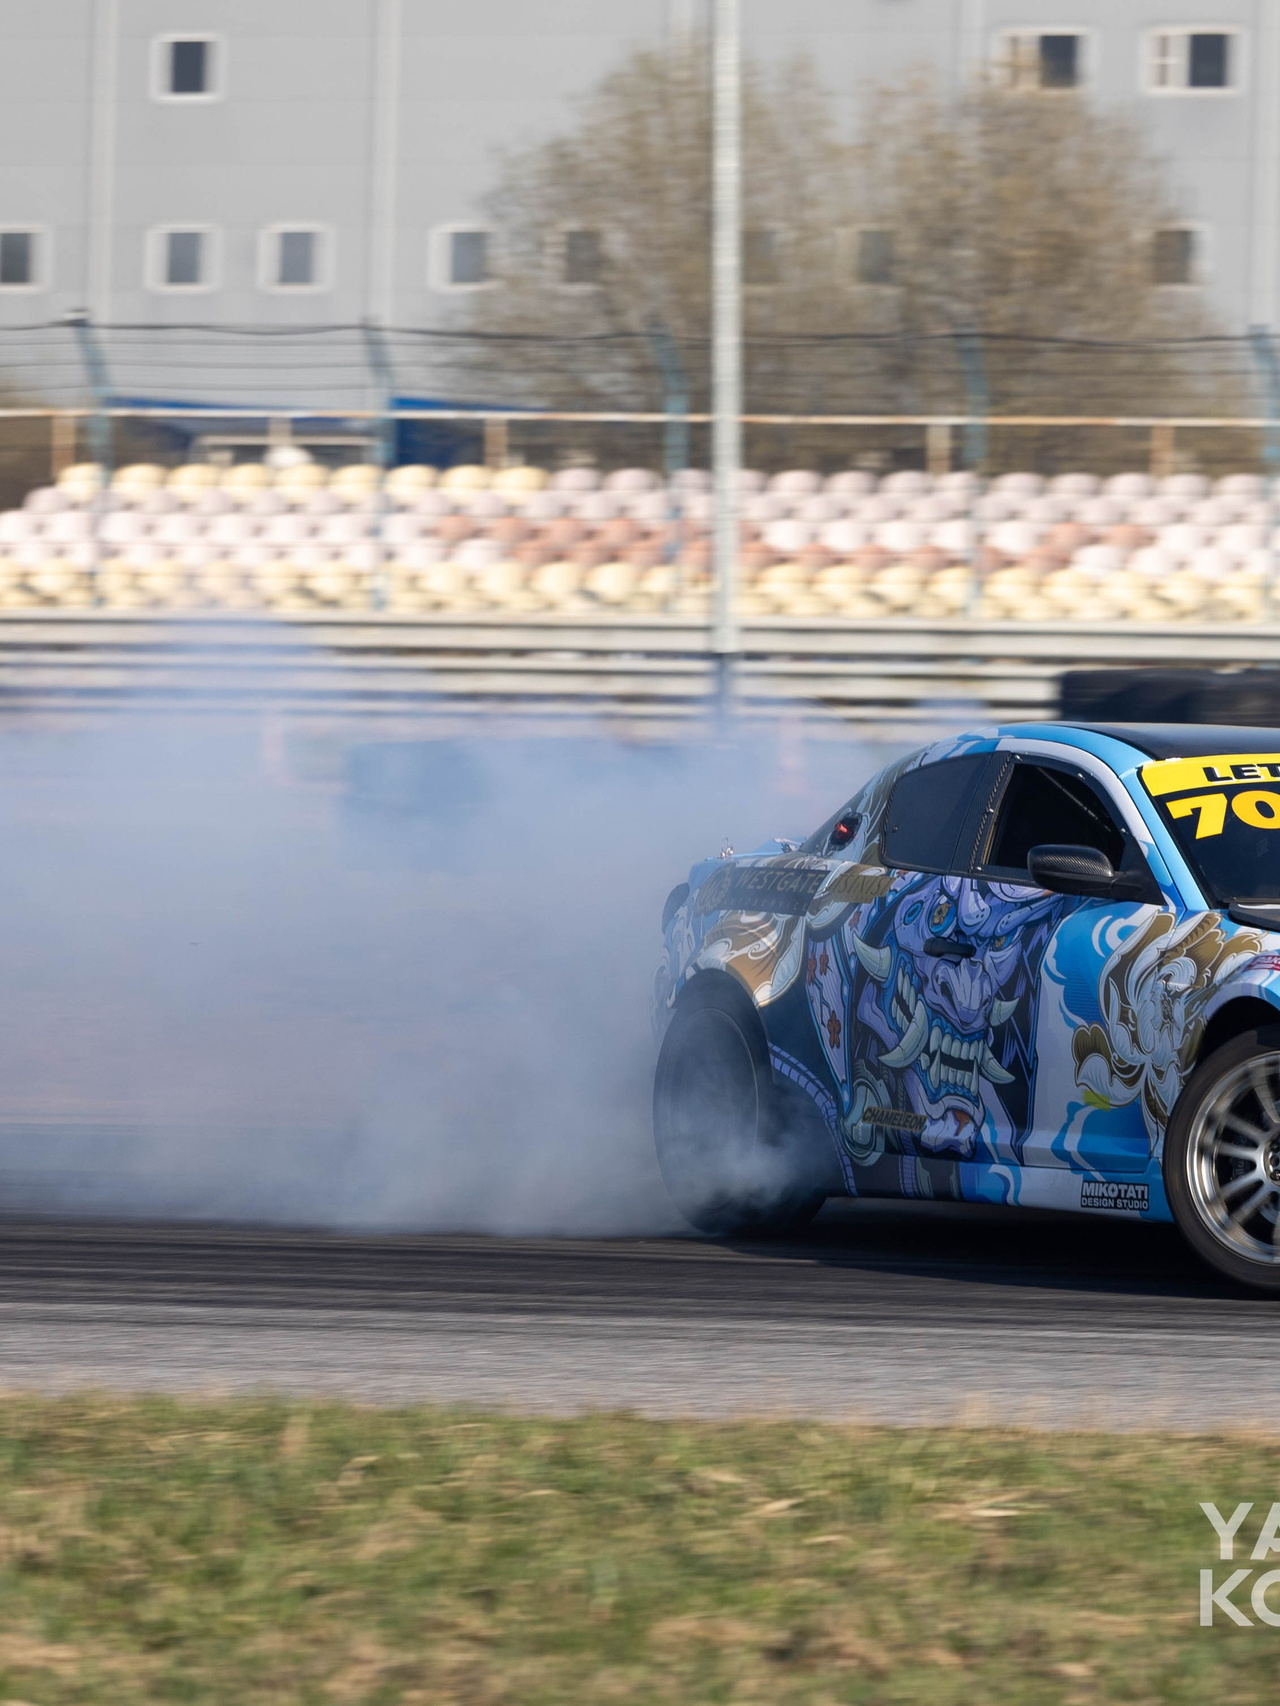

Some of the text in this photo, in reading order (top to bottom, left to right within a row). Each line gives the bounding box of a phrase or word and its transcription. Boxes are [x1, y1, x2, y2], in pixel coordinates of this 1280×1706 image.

[735, 867, 826, 894] WESTGATE
[862, 1107, 927, 1131] CHAMELEON
[1082, 1182, 1148, 1199] MIKOTATI
[1081, 1197, 1148, 1210] DESIGN STUDIO
